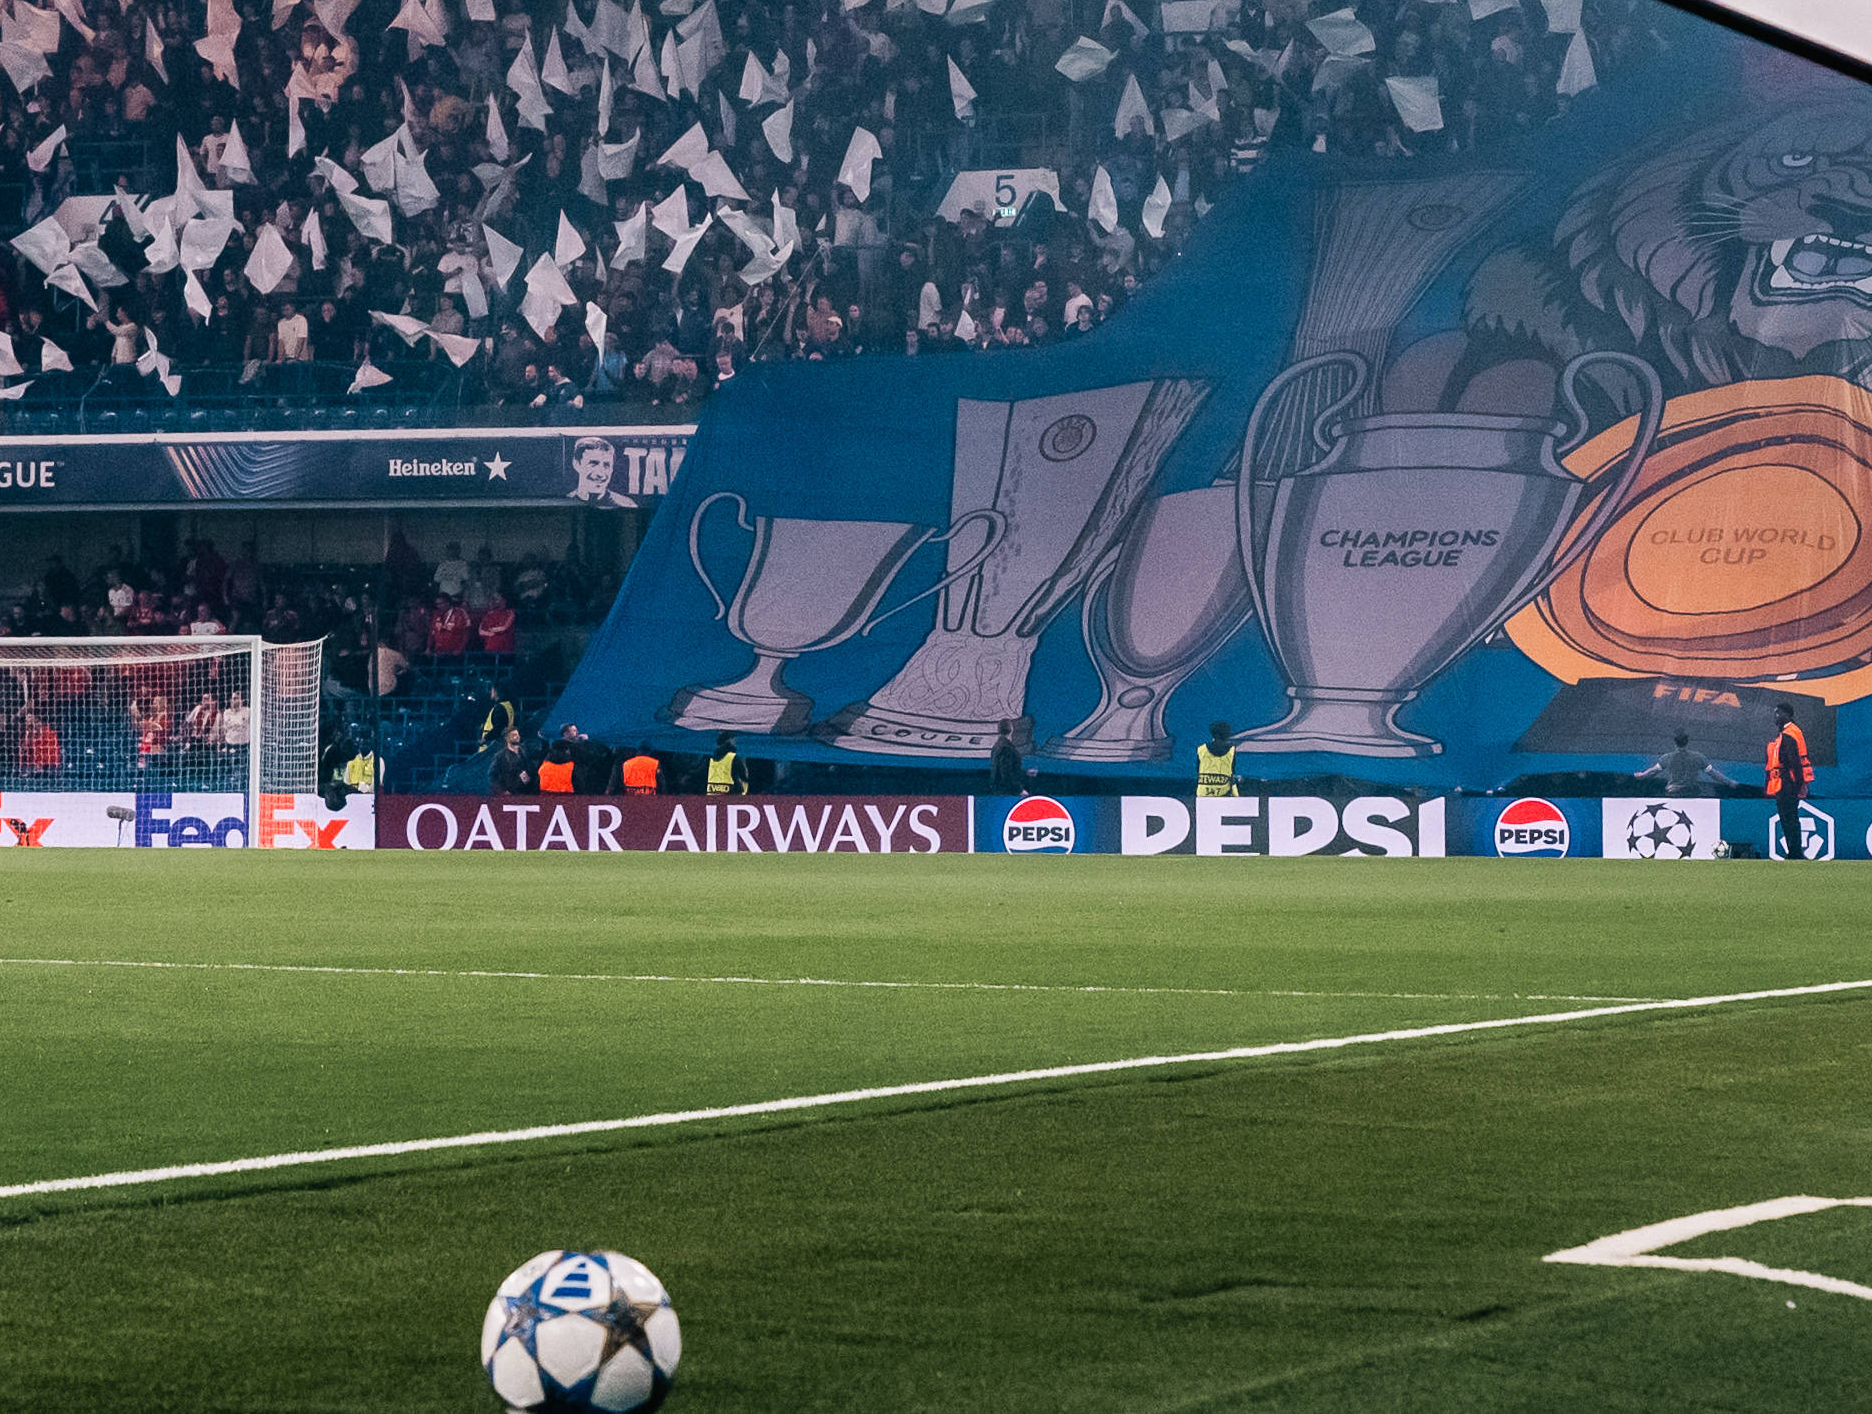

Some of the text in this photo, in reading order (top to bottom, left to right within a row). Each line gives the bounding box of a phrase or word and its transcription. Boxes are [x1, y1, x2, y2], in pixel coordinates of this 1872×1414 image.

[995, 174, 1017, 207] 5
[388, 458, 476, 478] Heineken
[1319, 529, 1501, 549] CHAMPIONS
[1650, 526, 1839, 553] CLUB WORLD
[1343, 549, 1464, 568] LEAGUE
[1699, 547, 1767, 565] CUP
[1653, 683, 1742, 708] FIFA
[870, 723, 985, 746] COUPE
[135, 792, 350, 850] FedEx
[405, 802, 943, 854] QATAR AIRWAYS
[1120, 795, 1446, 858] PEPSI
[1007, 825, 1071, 843] PEPSI
[1499, 827, 1566, 846] PEPSI
